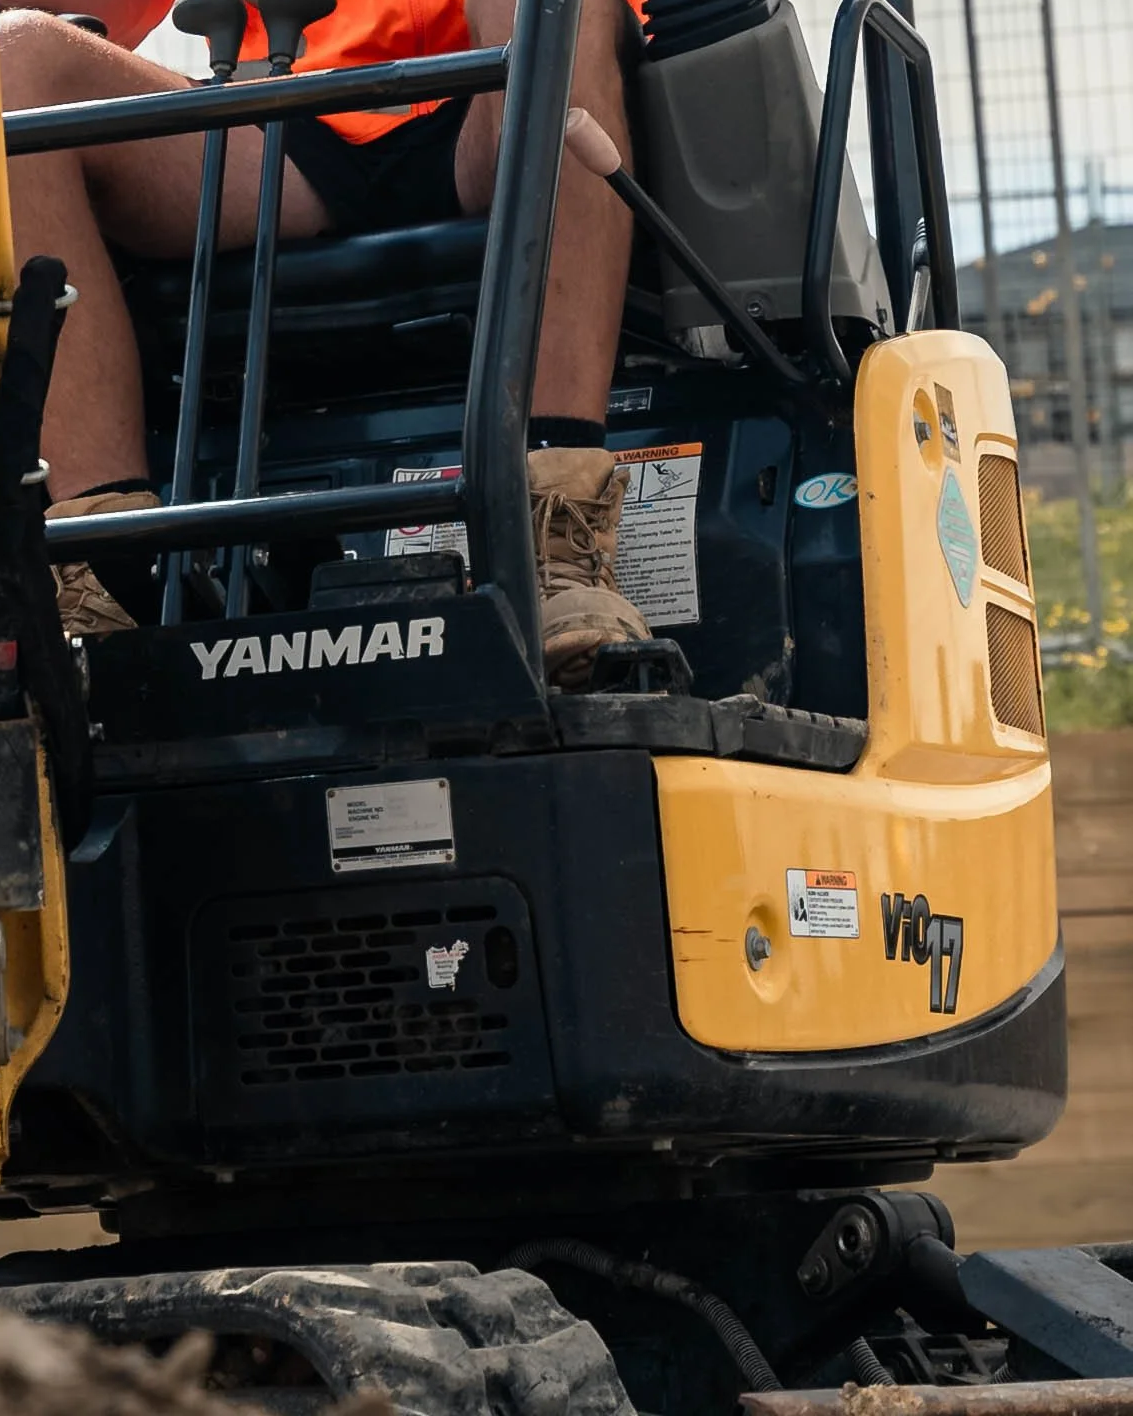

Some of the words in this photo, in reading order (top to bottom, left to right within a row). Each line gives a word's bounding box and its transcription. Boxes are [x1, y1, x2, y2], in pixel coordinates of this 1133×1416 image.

[623, 447, 680, 461] WARNING
[802, 478, 852, 503] OK
[190, 617, 445, 680] YANMAR
[375, 844, 410, 854] YANMAR
[820, 874, 848, 886] WARNING
